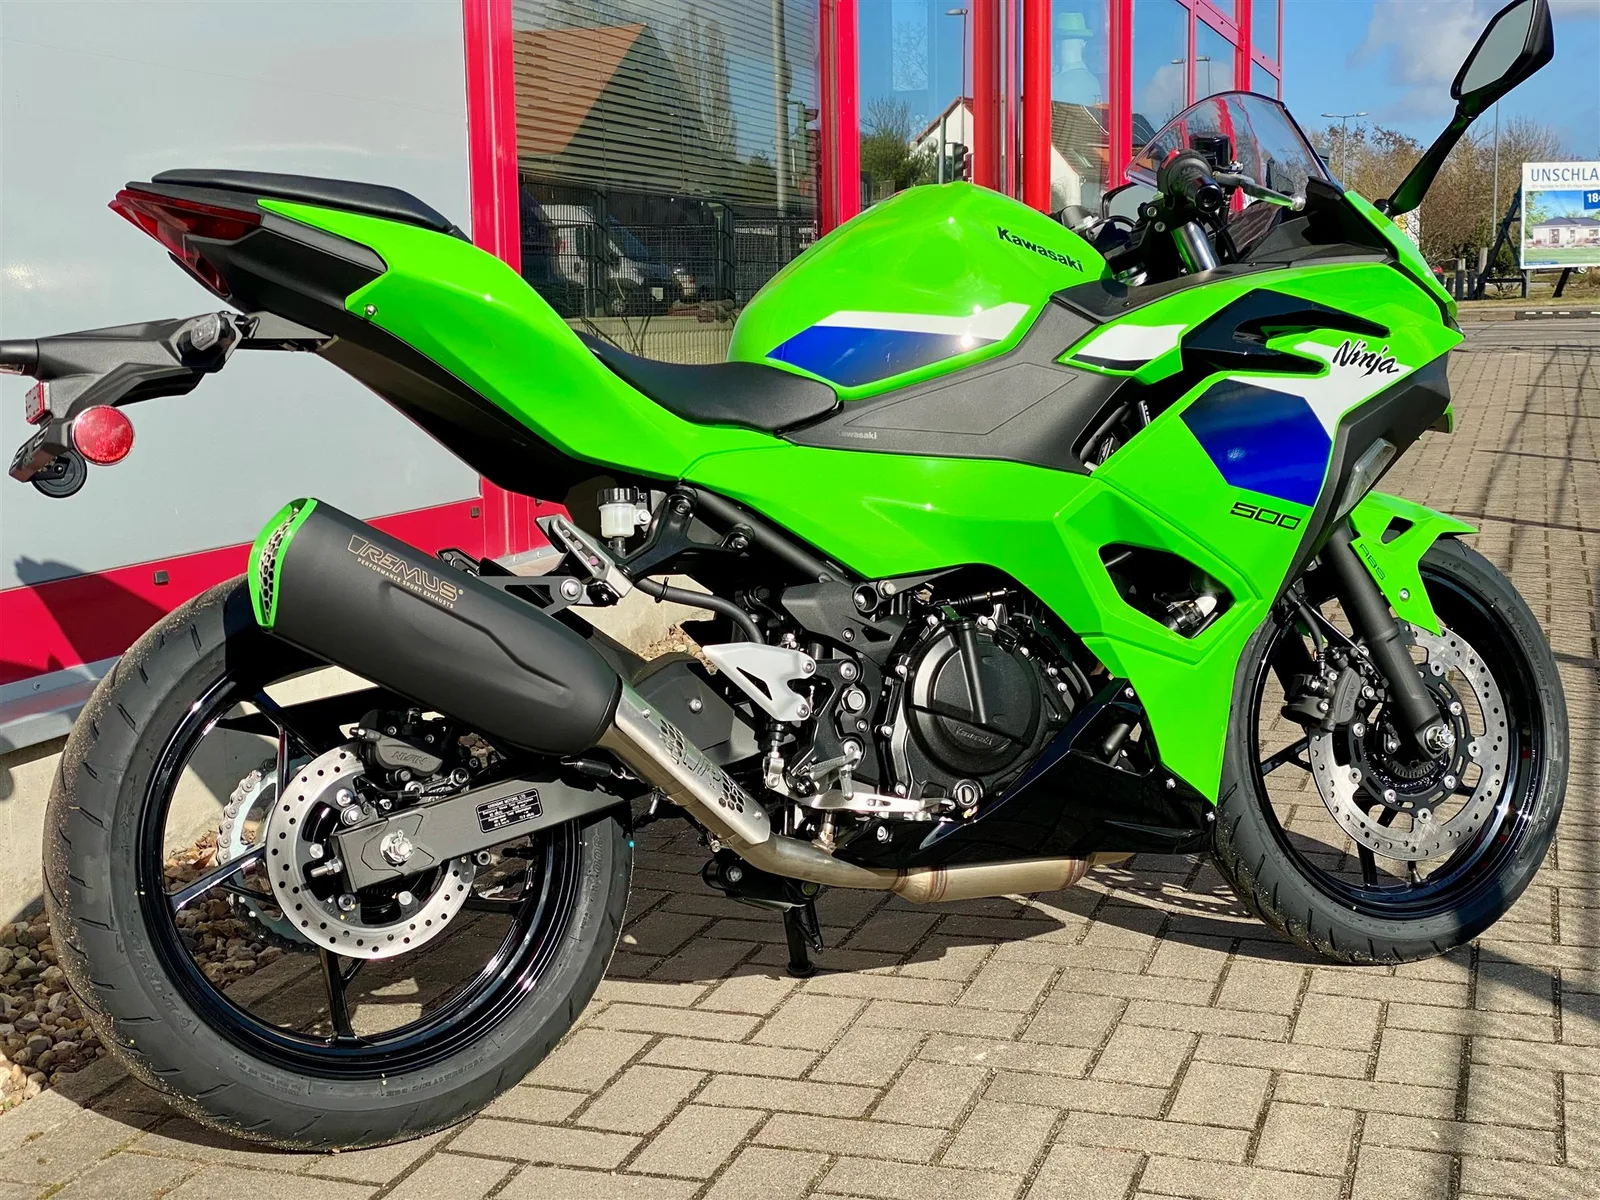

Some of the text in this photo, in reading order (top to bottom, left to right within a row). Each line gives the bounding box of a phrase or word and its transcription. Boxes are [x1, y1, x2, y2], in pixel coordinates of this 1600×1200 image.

[1531, 168, 1599, 182] UNSCHLA
[1587, 193, 1600, 203] 18
[997, 226, 1084, 273] Kawasaki
[1332, 340, 1399, 378] Ninja
[1230, 502, 1301, 530] 500
[359, 543, 458, 602] REMUS
[1359, 543, 1386, 581] ABS
[357, 557, 455, 609] PERFORMANCE SPORT EXHAUSTS
